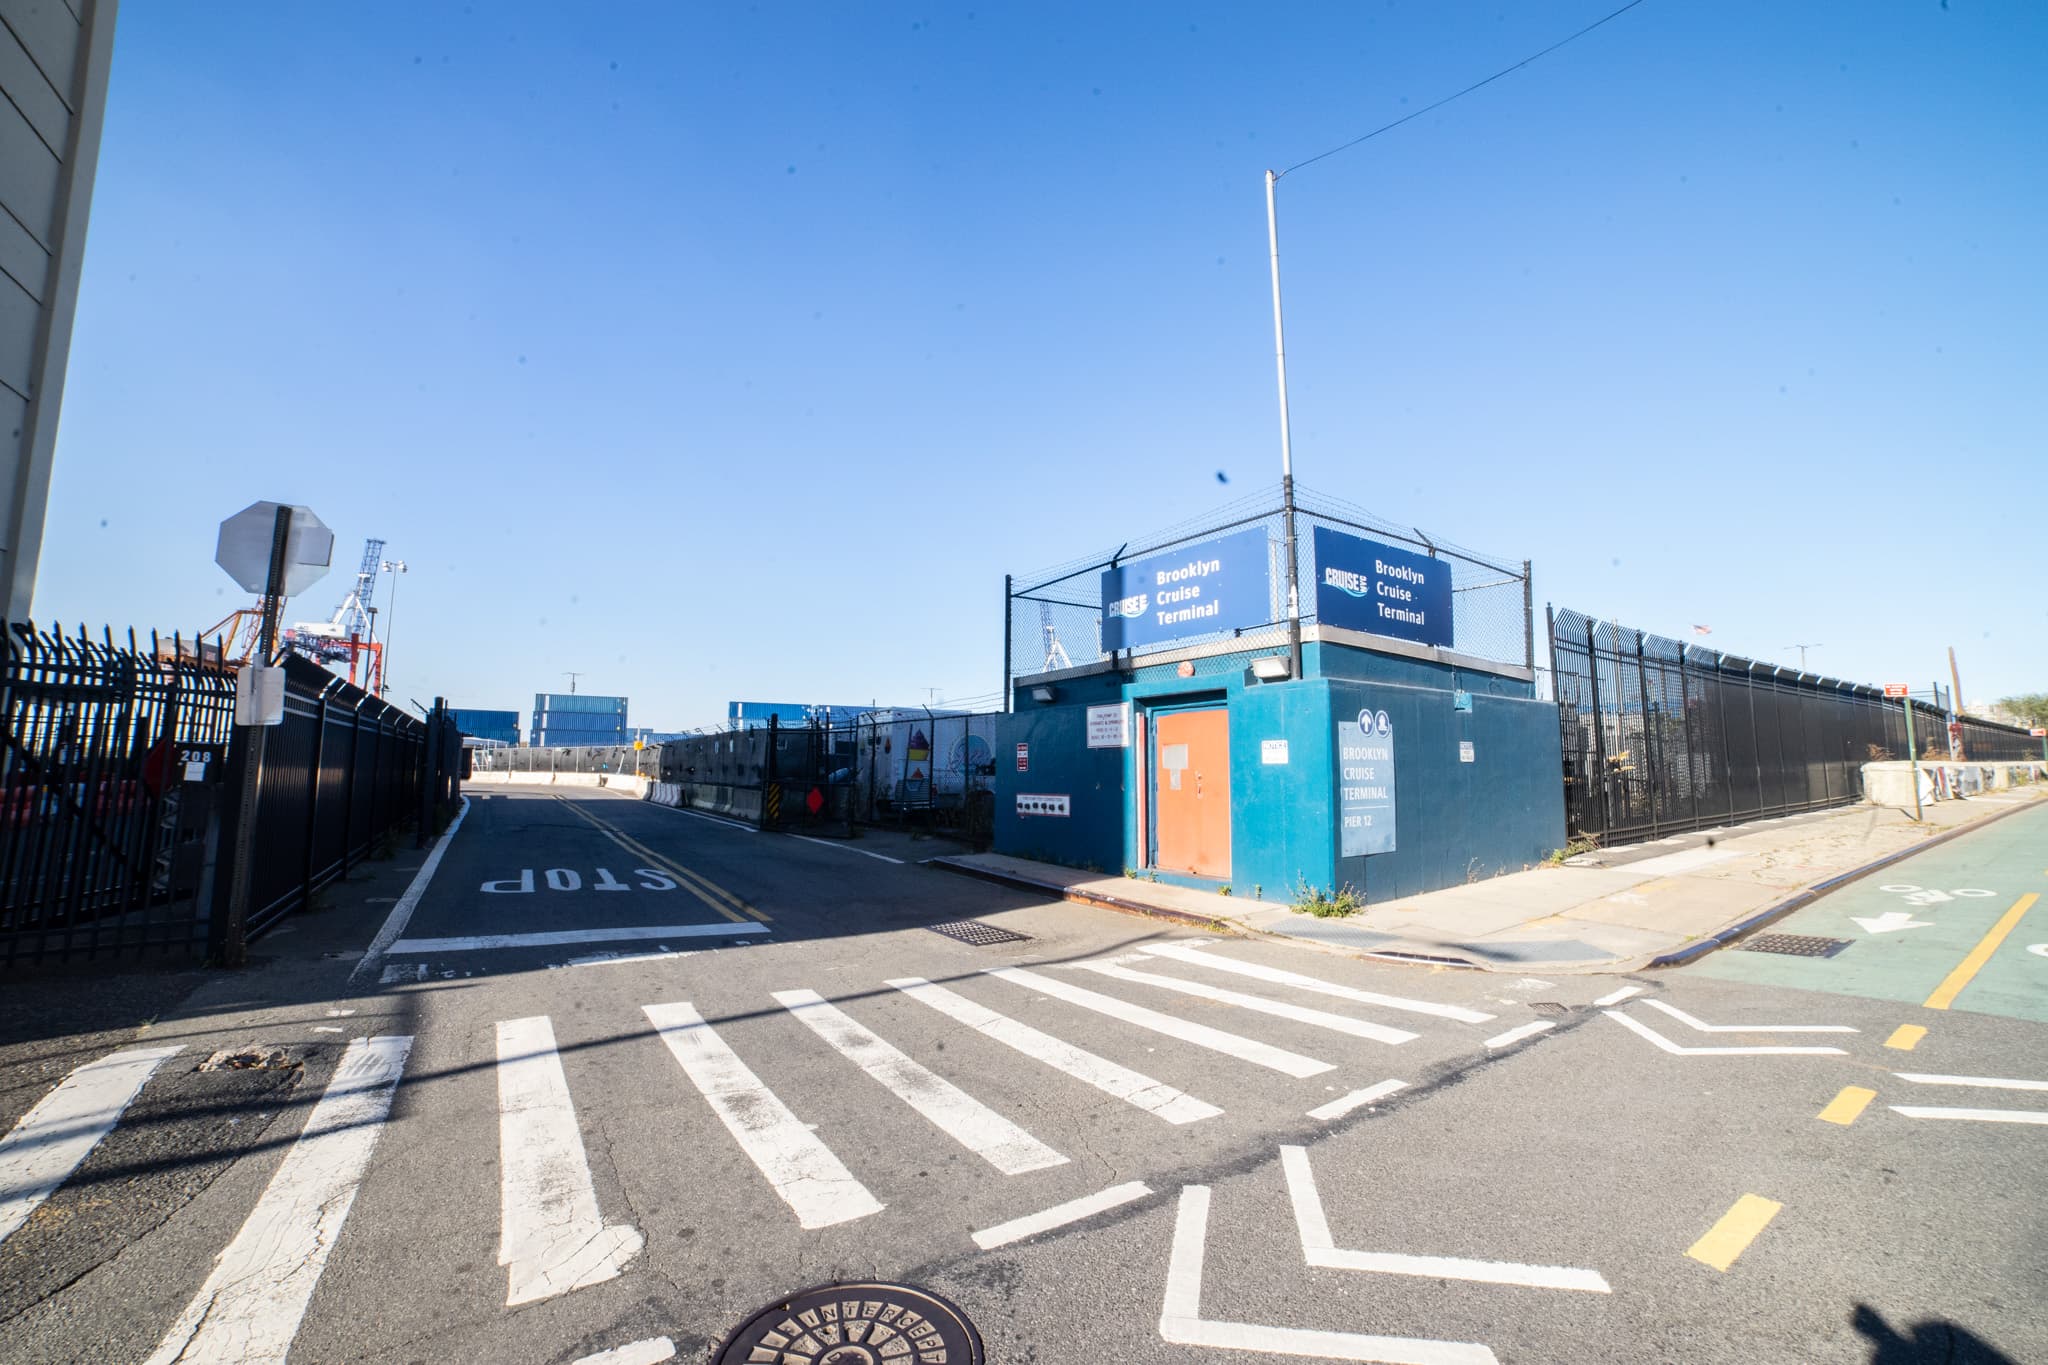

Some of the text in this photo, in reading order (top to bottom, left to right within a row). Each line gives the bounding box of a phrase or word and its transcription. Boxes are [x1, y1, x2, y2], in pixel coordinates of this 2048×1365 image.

[1157, 560, 1220, 585] Brooklyn
[1325, 567, 1359, 591] CRUISE
[1375, 560, 1424, 584] Brooklyn
[1157, 586, 1200, 605] Cruise
[1376, 582, 1411, 601] Cruise
[1109, 596, 1139, 616] CRUISE
[1157, 600, 1219, 625] Terminal
[1377, 602, 1424, 625] Terminal
[181, 750, 211, 762] 208
[1343, 747, 1388, 760] BROOKLYN
[1344, 767, 1375, 780] CRUISE
[1344, 787, 1388, 800] TERMINAL
[1344, 815, 1372, 828] PIER 12
[480, 868, 677, 893] STOP
